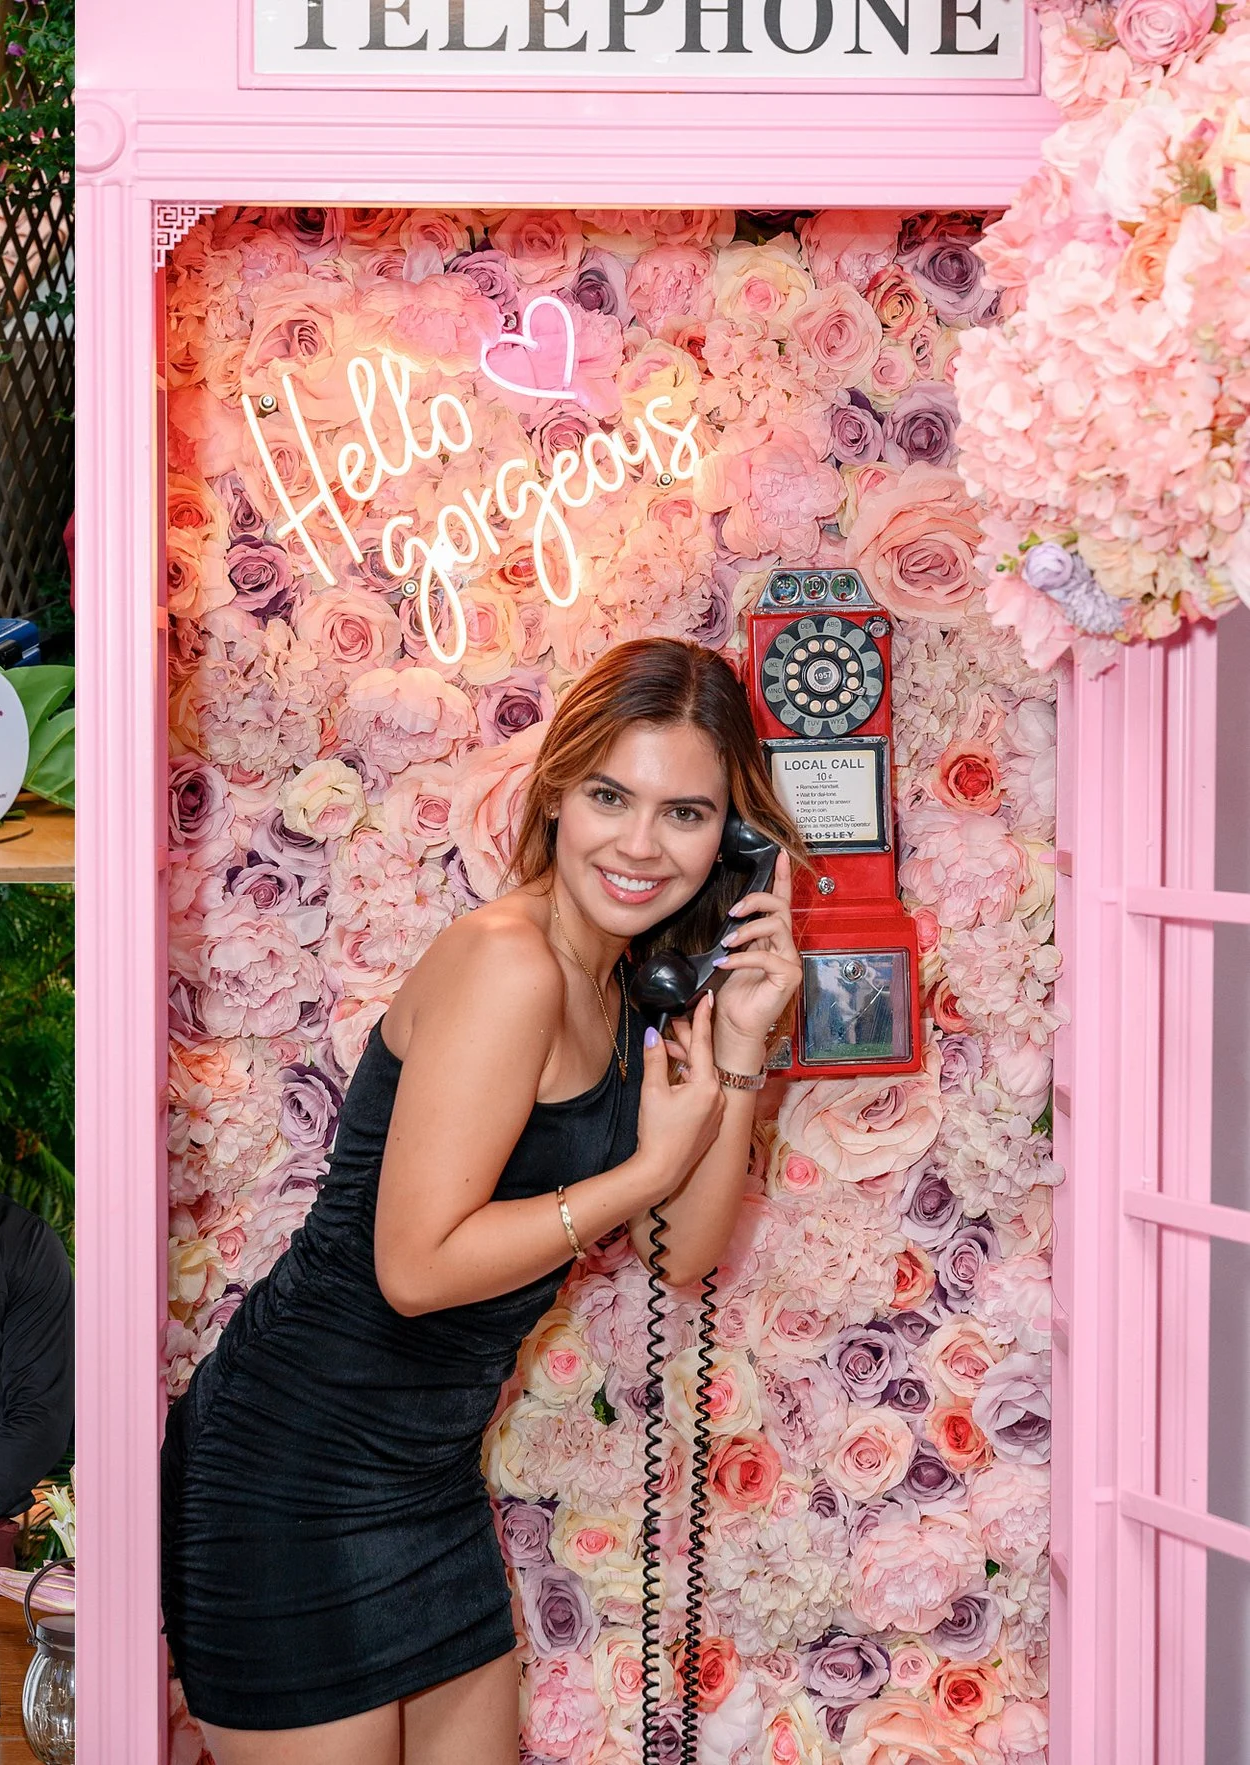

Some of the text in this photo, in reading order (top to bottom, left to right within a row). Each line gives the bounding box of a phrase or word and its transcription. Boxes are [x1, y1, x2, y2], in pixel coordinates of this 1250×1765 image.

[293, 0, 1000, 55] TELEPHONE
[240, 355, 474, 586] Hello
[381, 394, 700, 665] gorgeous
[776, 579, 791, 589] 25
[808, 580, 820, 591] 10
[814, 671, 832, 681] 1957
[784, 758, 865, 771] LOCAL CALL
[817, 772, 827, 781] 10
[796, 815, 855, 824] LONG DISTANCE
